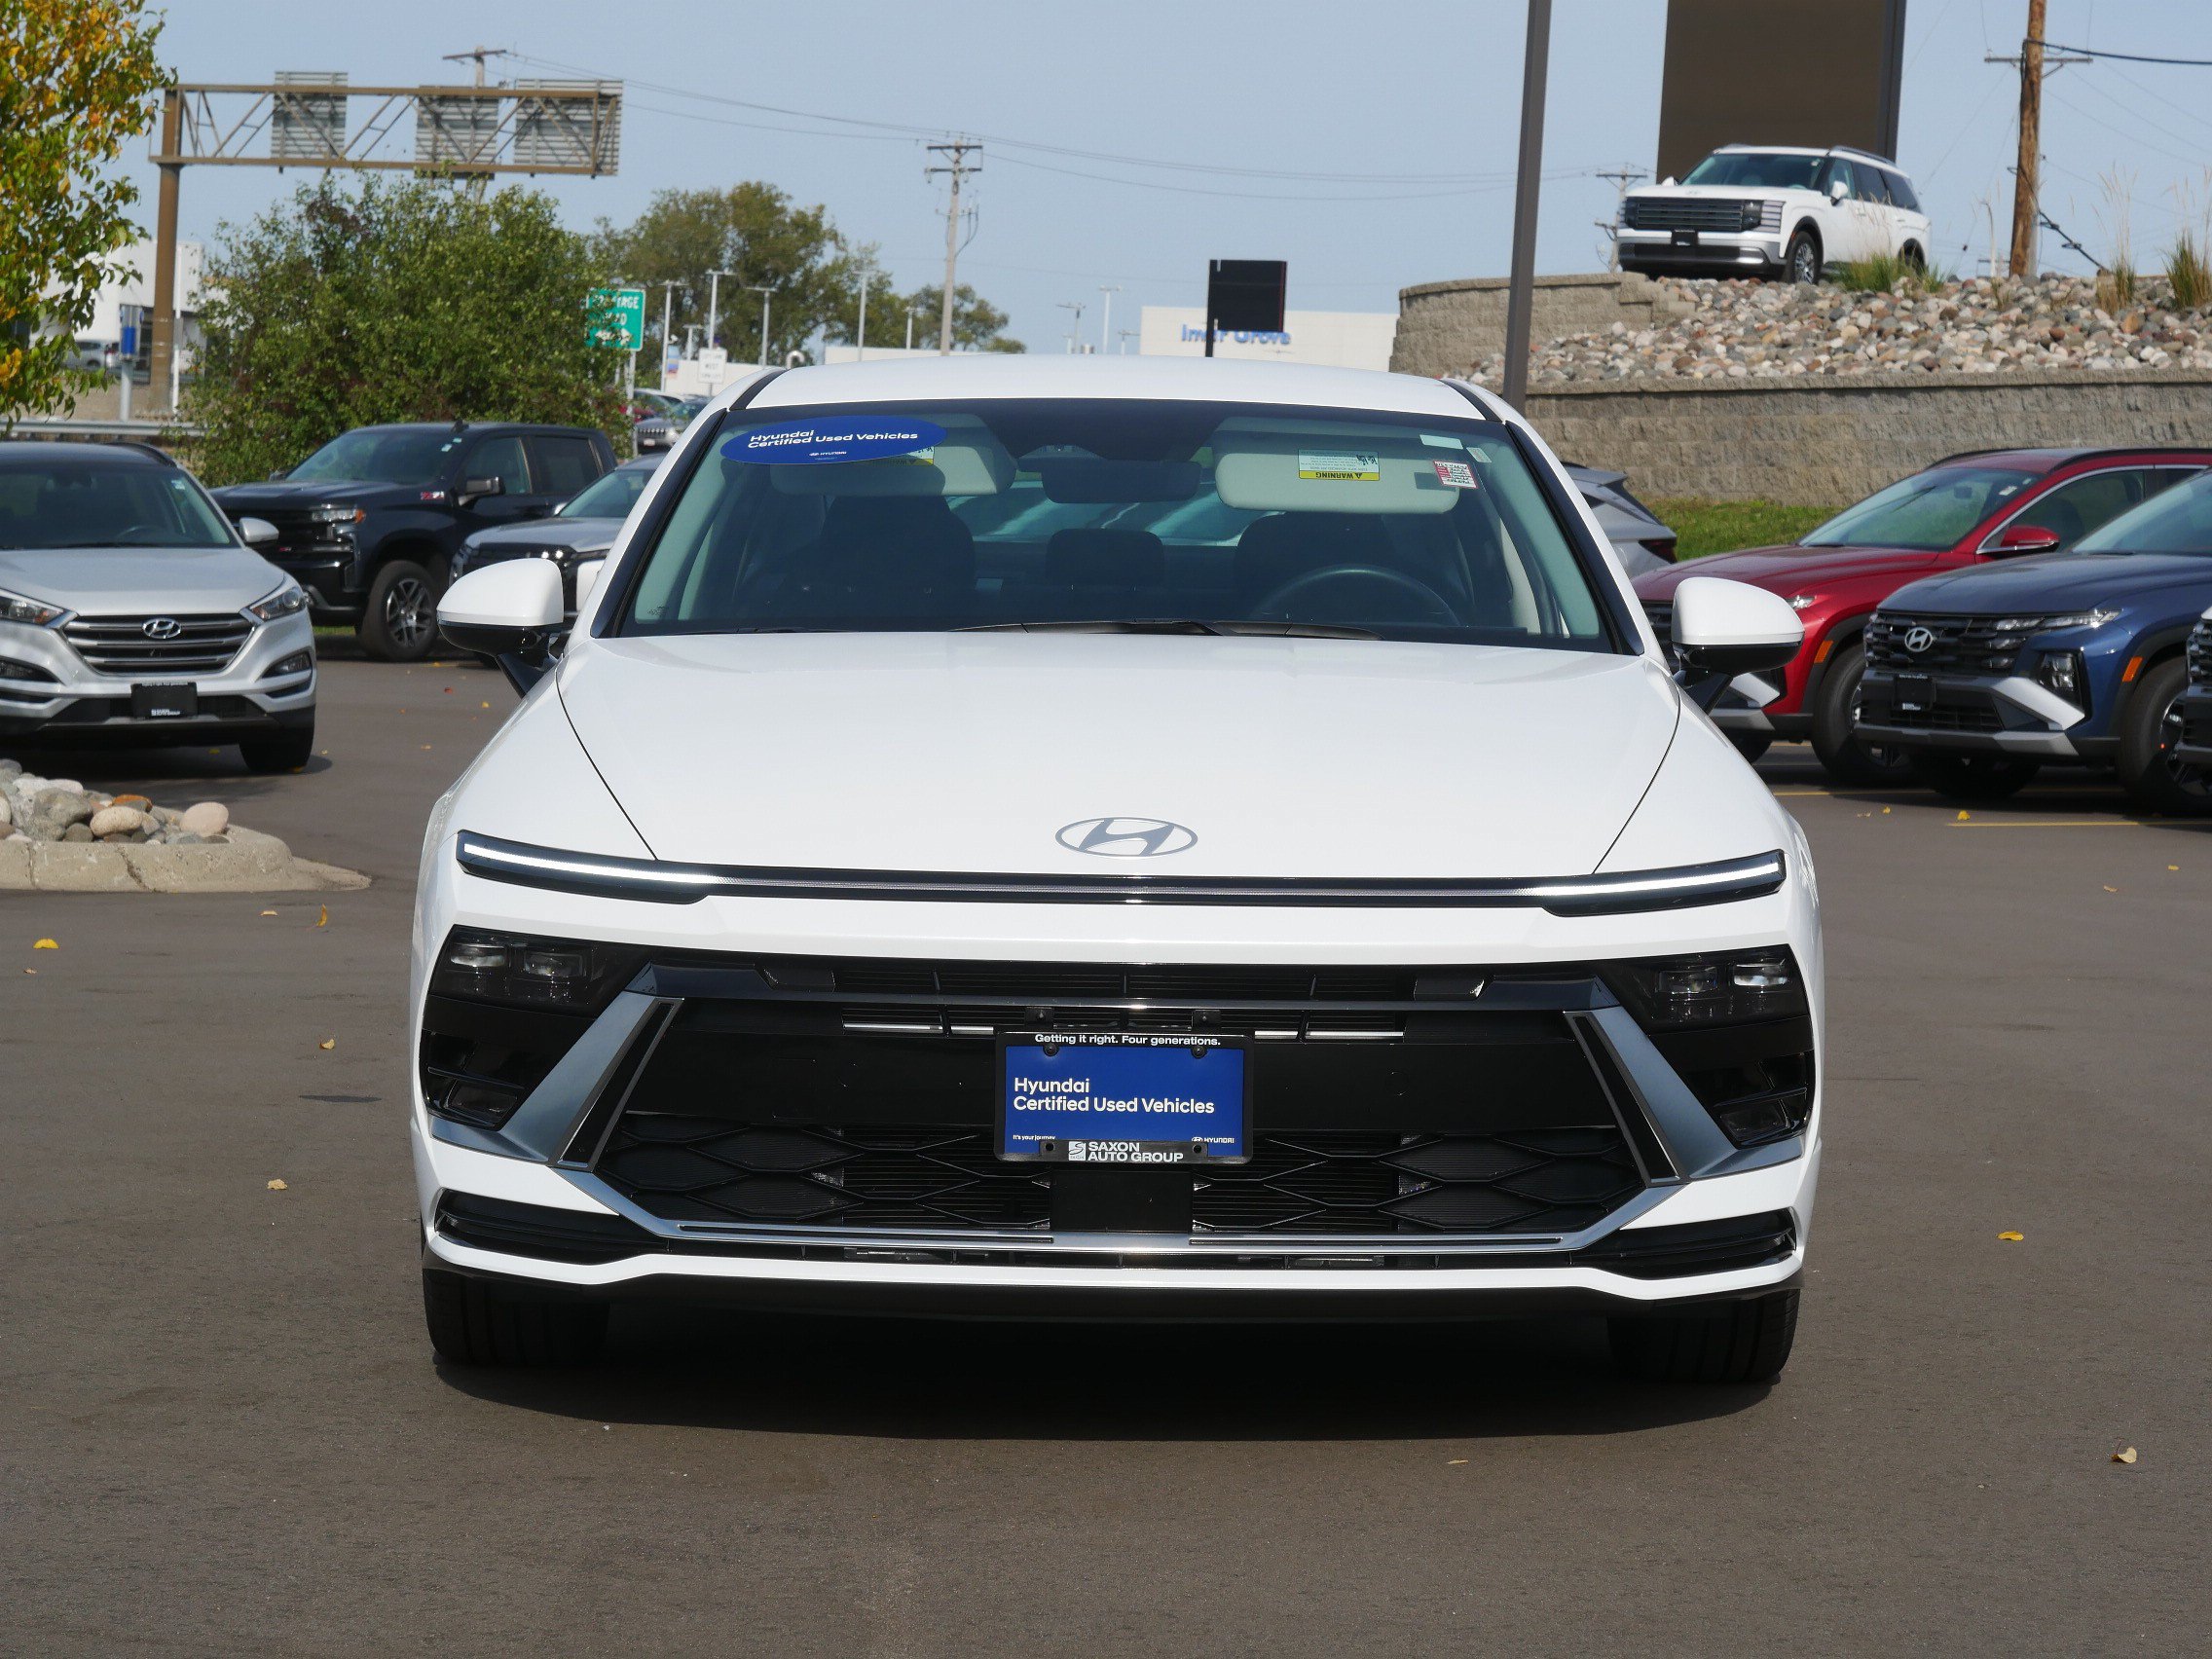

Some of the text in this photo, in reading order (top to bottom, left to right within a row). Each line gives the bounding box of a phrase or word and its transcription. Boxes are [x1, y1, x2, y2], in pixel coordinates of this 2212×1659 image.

[748, 432, 918, 449] Certified Used Vehicles
[750, 429, 815, 443] Hyundai
[1034, 1034, 1221, 1046] Getting it right. Four generations.
[1014, 1078, 1090, 1095] Hyundai
[1014, 1096, 1215, 1114] Certified Used Vehicles
[1088, 1141, 1140, 1152] SAXON
[1088, 1152, 1184, 1162] AUTO GROUP
